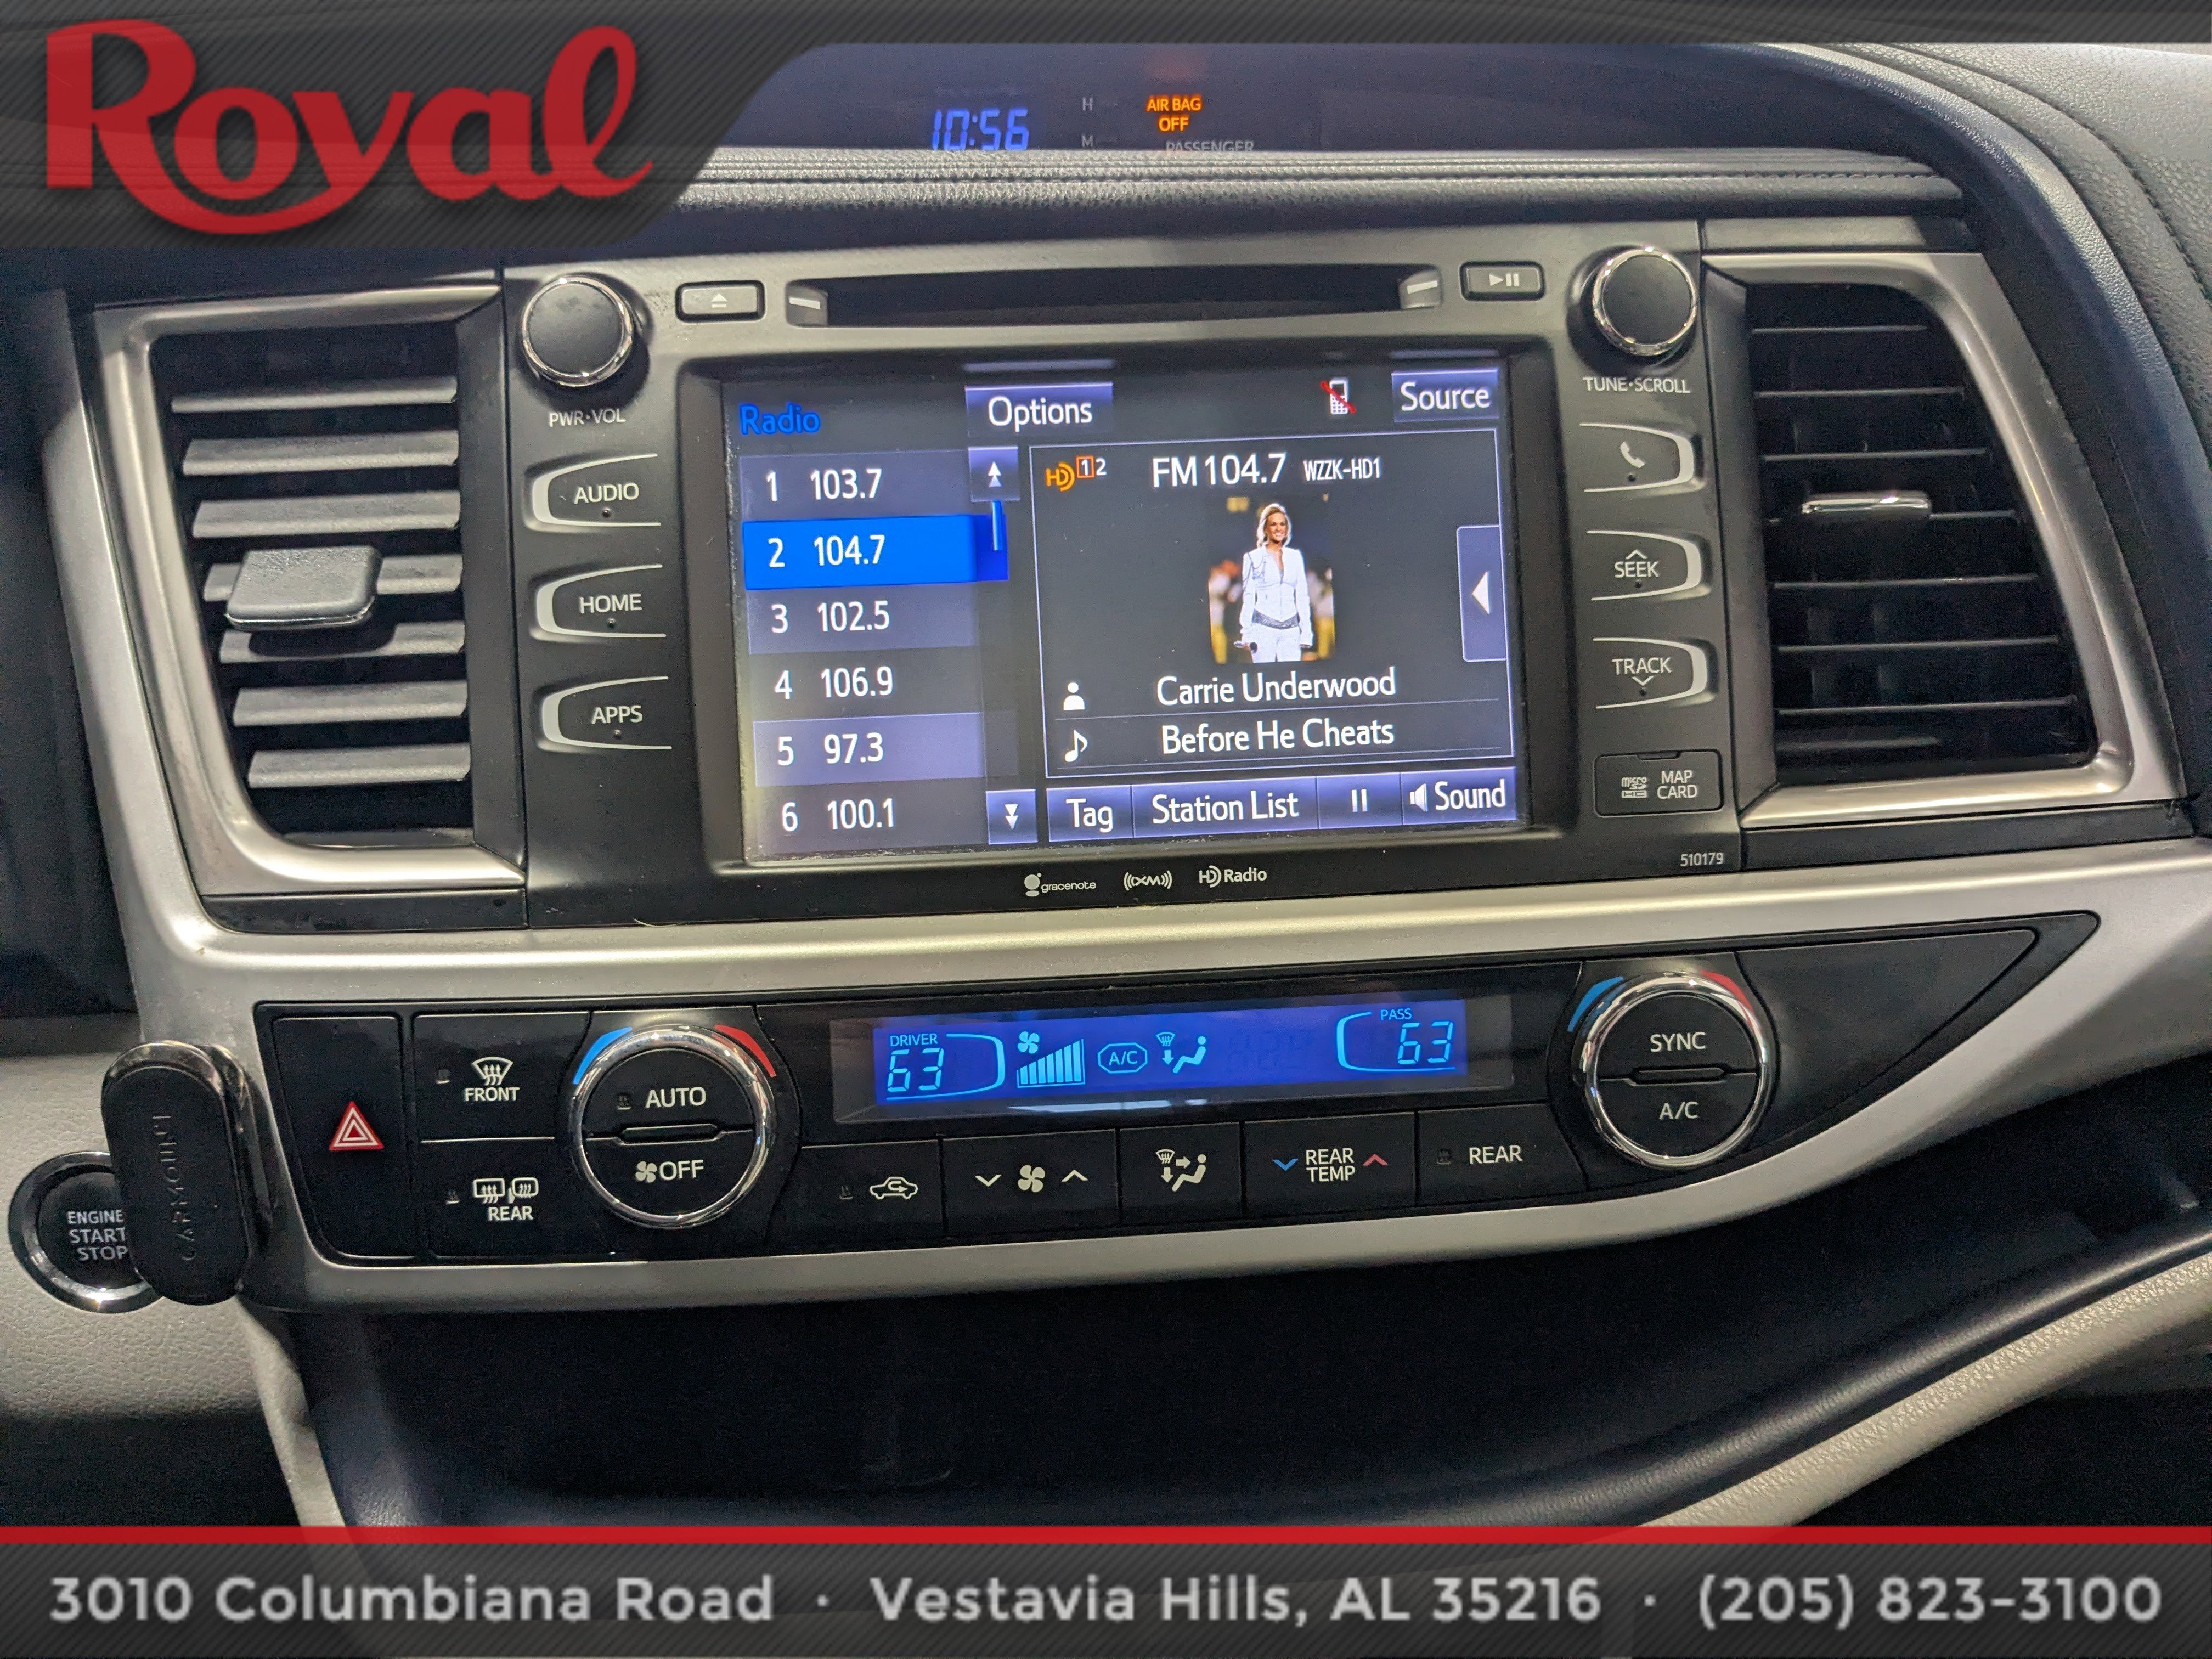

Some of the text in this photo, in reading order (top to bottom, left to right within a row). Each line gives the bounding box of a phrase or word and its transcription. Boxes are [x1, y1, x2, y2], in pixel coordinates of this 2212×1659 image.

[1082, 97, 1094, 111] H
[1147, 96, 1203, 112] AIR BAG
[932, 108, 1029, 151] 10:56
[1158, 116, 1189, 132] OFF
[1081, 135, 1094, 148] M
[1165, 140, 1255, 152] PASSENGER
[1400, 382, 1491, 413] Source
[739, 402, 821, 435] Radio
[988, 396, 1093, 433] Options
[1152, 453, 1382, 488] FM 104.7 WZZK-HD1
[573, 482, 640, 505] AUDIO
[766, 468, 883, 501] 1 103.7
[768, 534, 885, 568] 2 104.7
[1614, 560, 1660, 579] SEEK
[579, 593, 642, 615] HOME
[771, 600, 890, 634] 3 102.5
[1612, 656, 1672, 675] TRACK
[774, 666, 893, 700] 4 106.9
[1156, 667, 1397, 707] Carrie Underwood
[591, 704, 644, 725] APPS
[1161, 718, 1395, 755] Before He Cheats
[777, 732, 884, 766] 5 97.3
[1661, 770, 1693, 785] MAP
[1434, 778, 1506, 812] Sound
[1657, 784, 1699, 799] CARD
[781, 798, 895, 832] 6 100.1
[1065, 799, 1114, 833] Tag
[1152, 791, 1300, 824] Station List
[1680, 852, 1724, 867] 510179
[1224, 867, 1268, 883] Radio
[1041, 881, 1097, 894] gracenote
[1380, 1008, 1413, 1022] PASS
[889, 1032, 938, 1047] DRIVER
[1397, 1020, 1454, 1065] 63
[1650, 1031, 1707, 1053] SYNC
[1108, 1050, 1139, 1066] A/C
[887, 1047, 945, 1093] 63
[464, 1086, 521, 1102] FRONT
[645, 1086, 707, 1109] AUTO
[1658, 1101, 1700, 1120] A/C
[1305, 1147, 1355, 1165] REAR
[1469, 1144, 1523, 1165] REAR
[659, 1159, 704, 1181] OFF
[1306, 1165, 1356, 1183] TEMP
[67, 1209, 125, 1224] ENGINE
[487, 1205, 534, 1221] REAR
[69, 1227, 126, 1244] START
[76, 1245, 128, 1261] STOP
